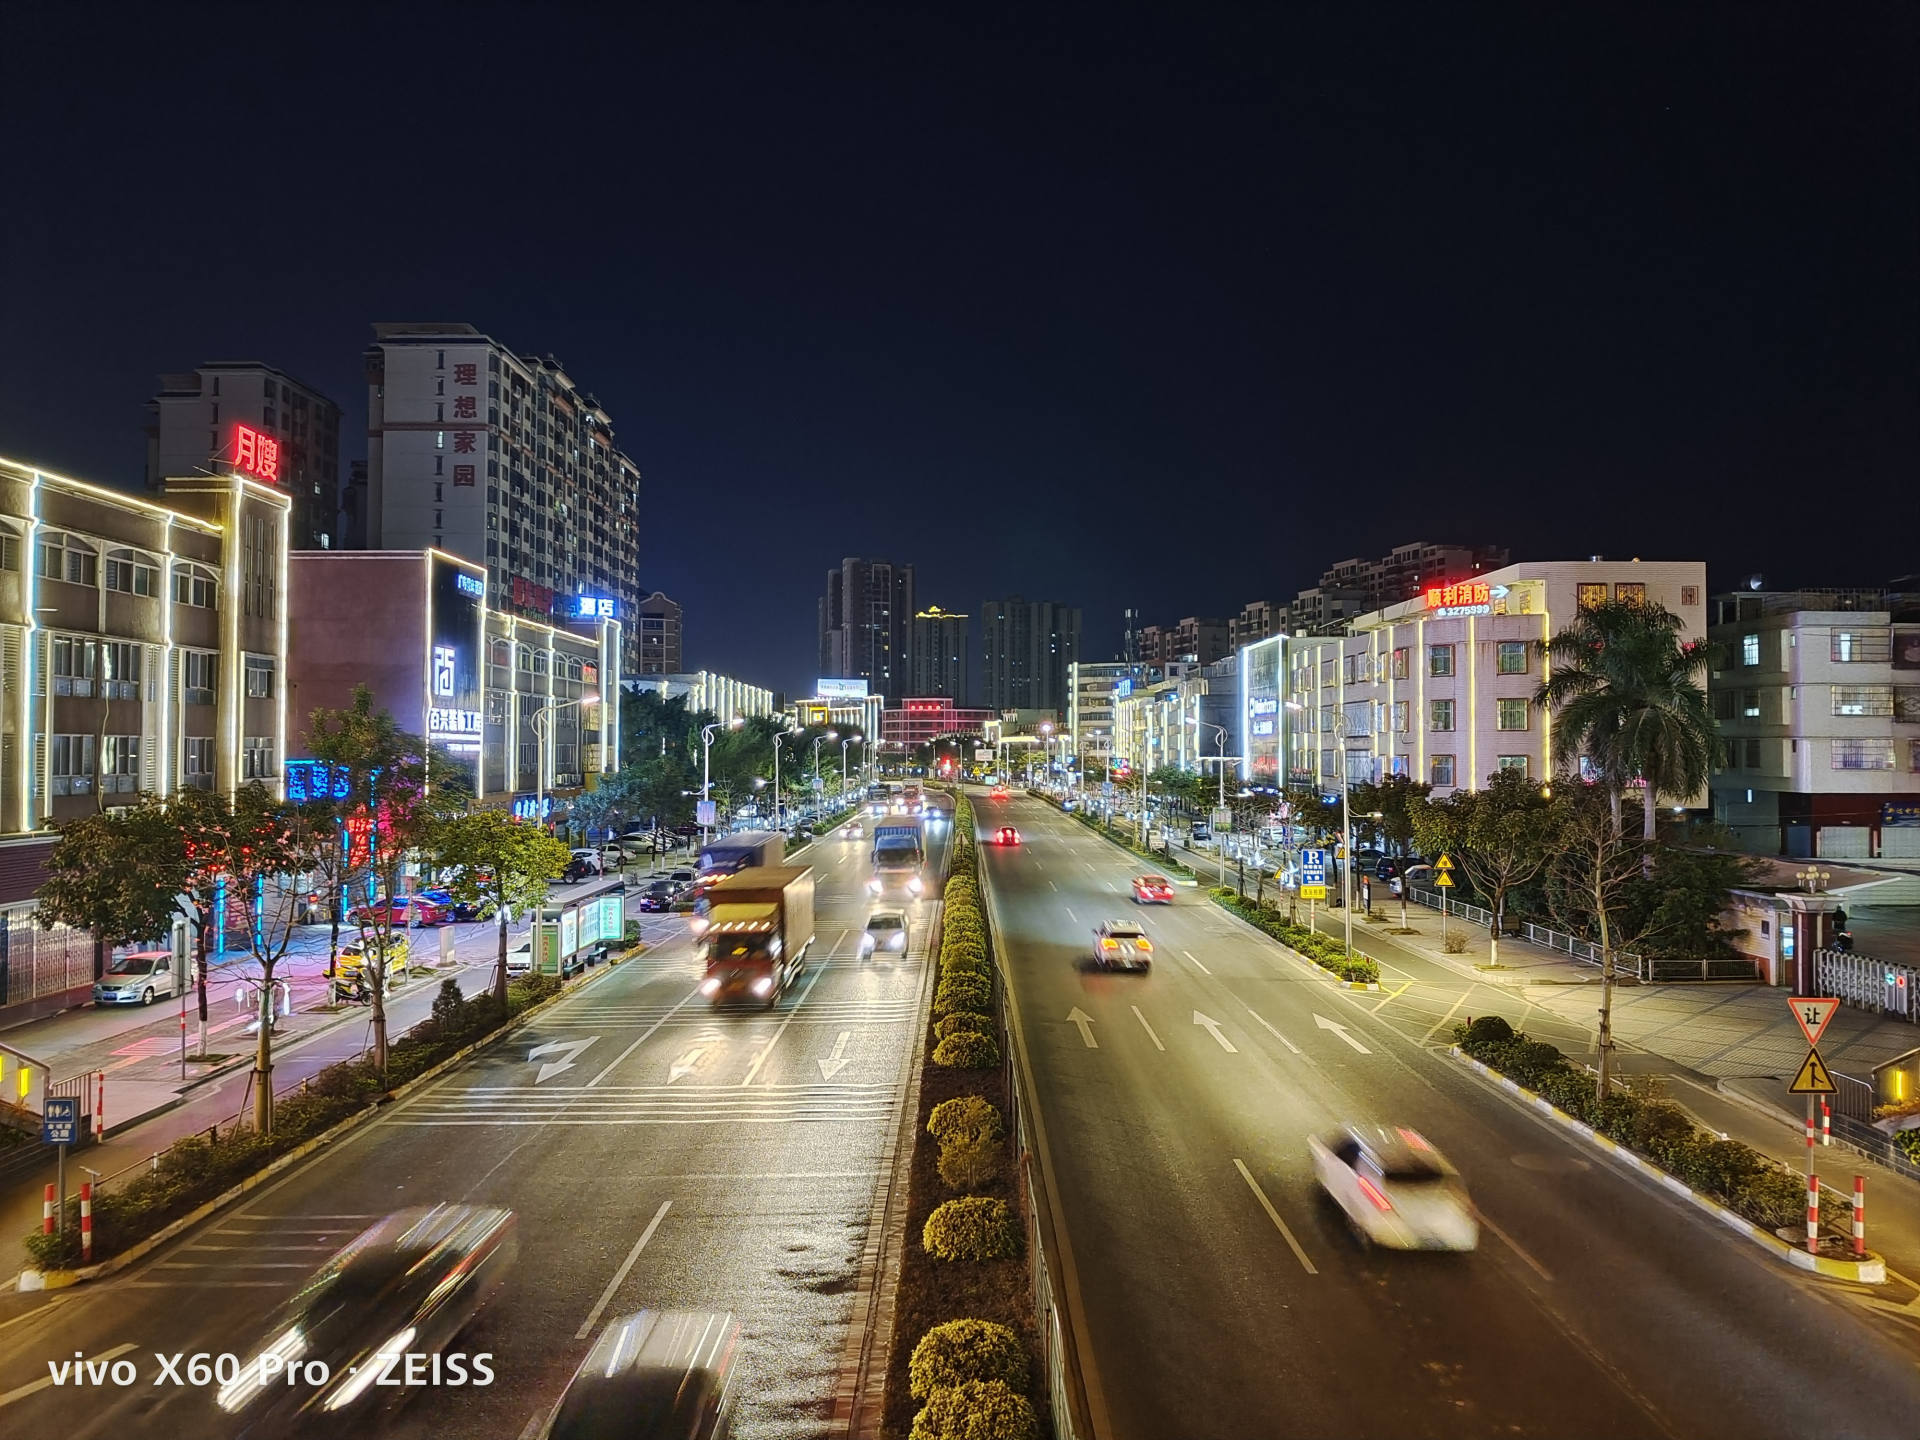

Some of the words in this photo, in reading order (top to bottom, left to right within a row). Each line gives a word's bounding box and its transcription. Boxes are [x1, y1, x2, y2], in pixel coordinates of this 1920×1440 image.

[453, 363, 477, 487] 理想家园
[235, 424, 278, 480] 月嫂
[1427, 584, 1489, 607] 顺利消防
[1804, 1007, 1820, 1025] 让
